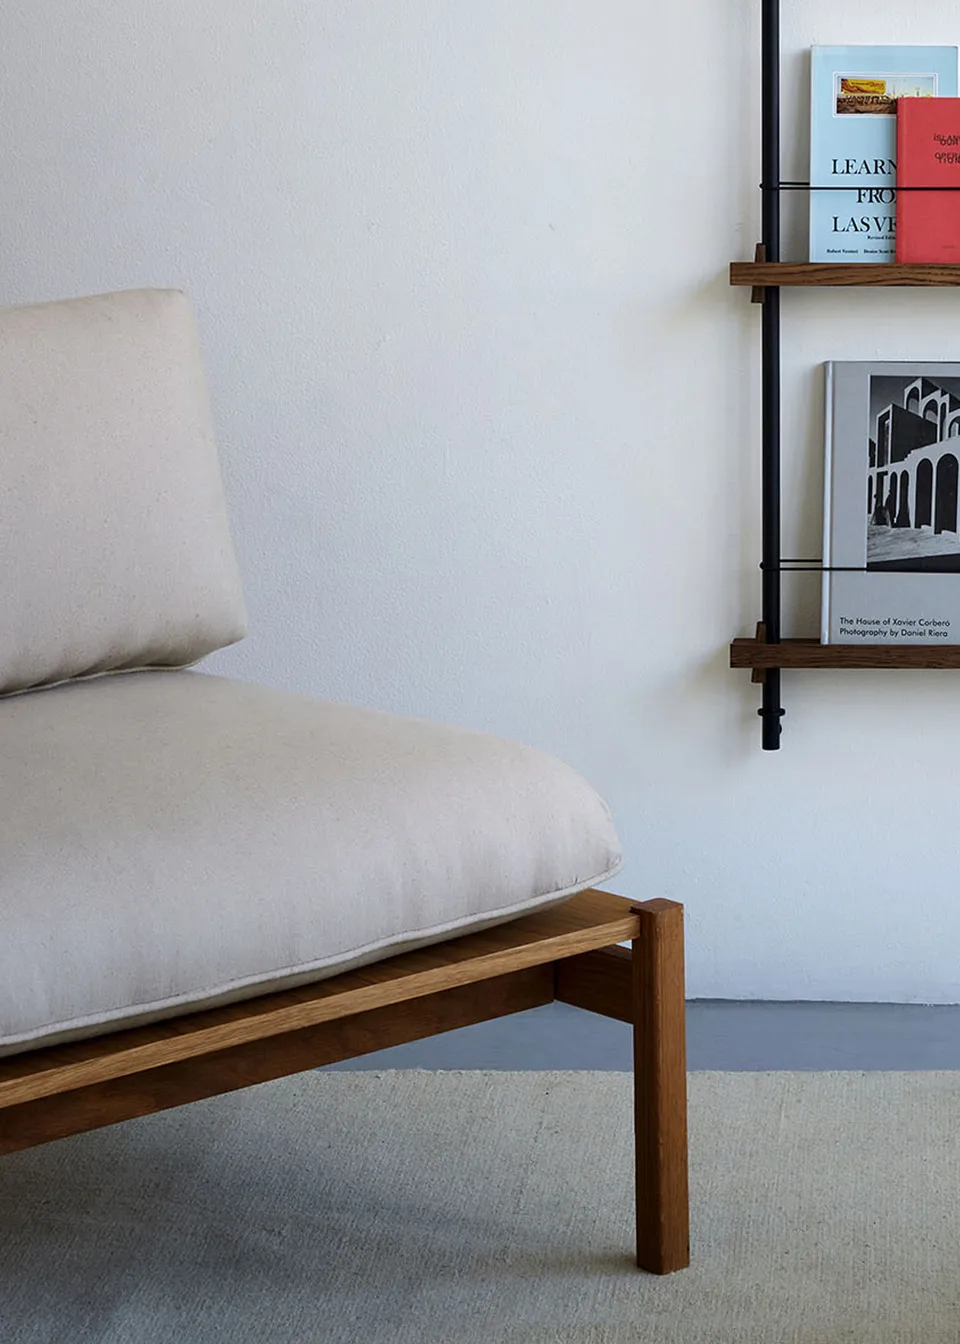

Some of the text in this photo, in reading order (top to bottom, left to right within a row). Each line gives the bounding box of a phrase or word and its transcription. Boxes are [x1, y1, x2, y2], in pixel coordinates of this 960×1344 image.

[857, 188, 897, 204] FRO
[832, 216, 871, 233] LAS
[839, 617, 854, 626] The
[856, 617, 881, 626] House
[882, 617, 891, 626] of
[892, 618, 917, 627] Xavier
[839, 627, 949, 638] Photography by Daniel Riera
